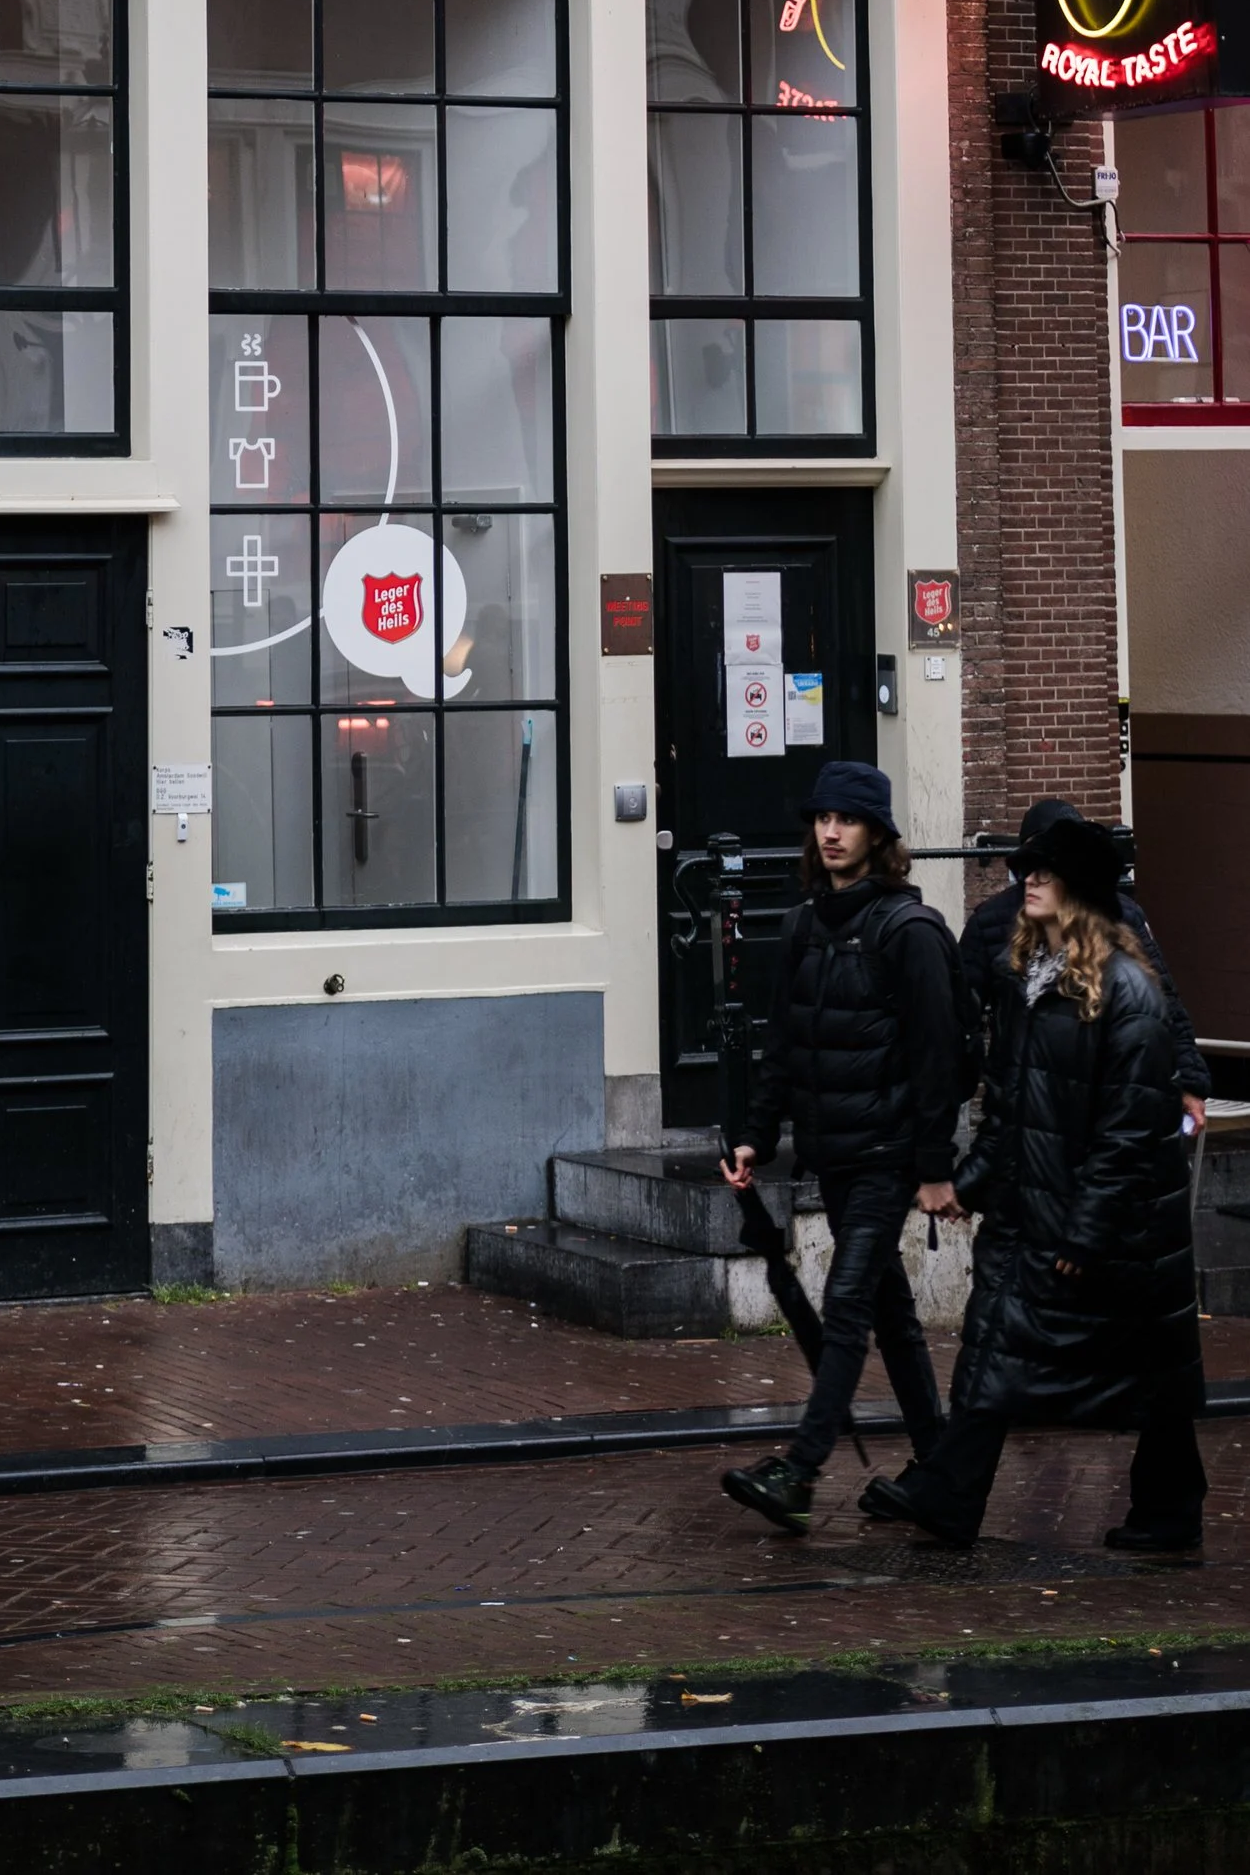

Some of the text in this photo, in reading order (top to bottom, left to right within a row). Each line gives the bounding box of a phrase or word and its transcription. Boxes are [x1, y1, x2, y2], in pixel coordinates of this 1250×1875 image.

[1041, 21, 1198, 89] ROYAL TASTE
[1121, 304, 1199, 362] BAR
[374, 584, 410, 603] Leger
[923, 588, 943, 600] Leger
[381, 600, 403, 615] des
[926, 598, 939, 607] des
[924, 605, 943, 616] Heils
[378, 613, 409, 631] Heils
[927, 627, 940, 638] 45
